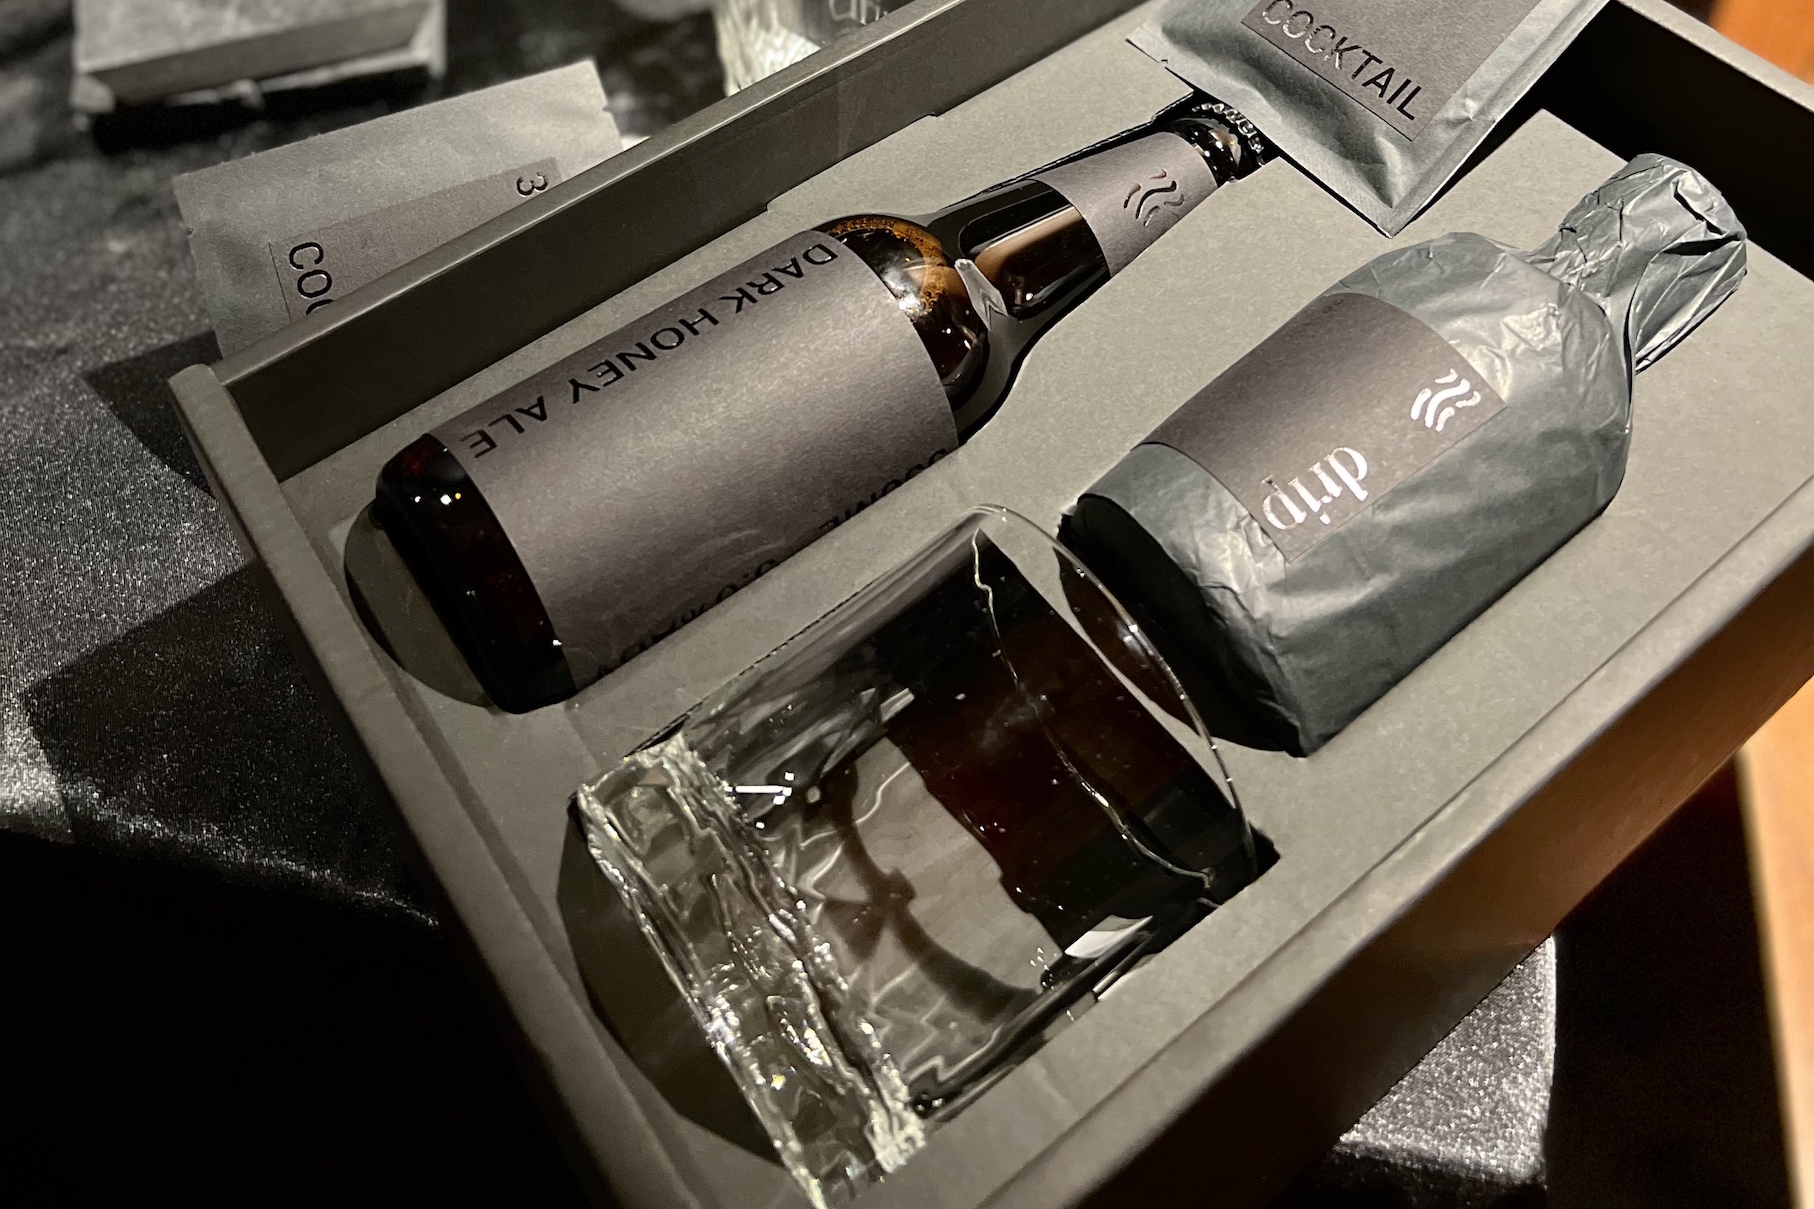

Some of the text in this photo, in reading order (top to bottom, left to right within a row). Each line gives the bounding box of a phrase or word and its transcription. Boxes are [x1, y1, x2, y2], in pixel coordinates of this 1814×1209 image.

[460, 243, 838, 458] DARK HONEY ALE
[1261, 447, 1368, 530] drip
